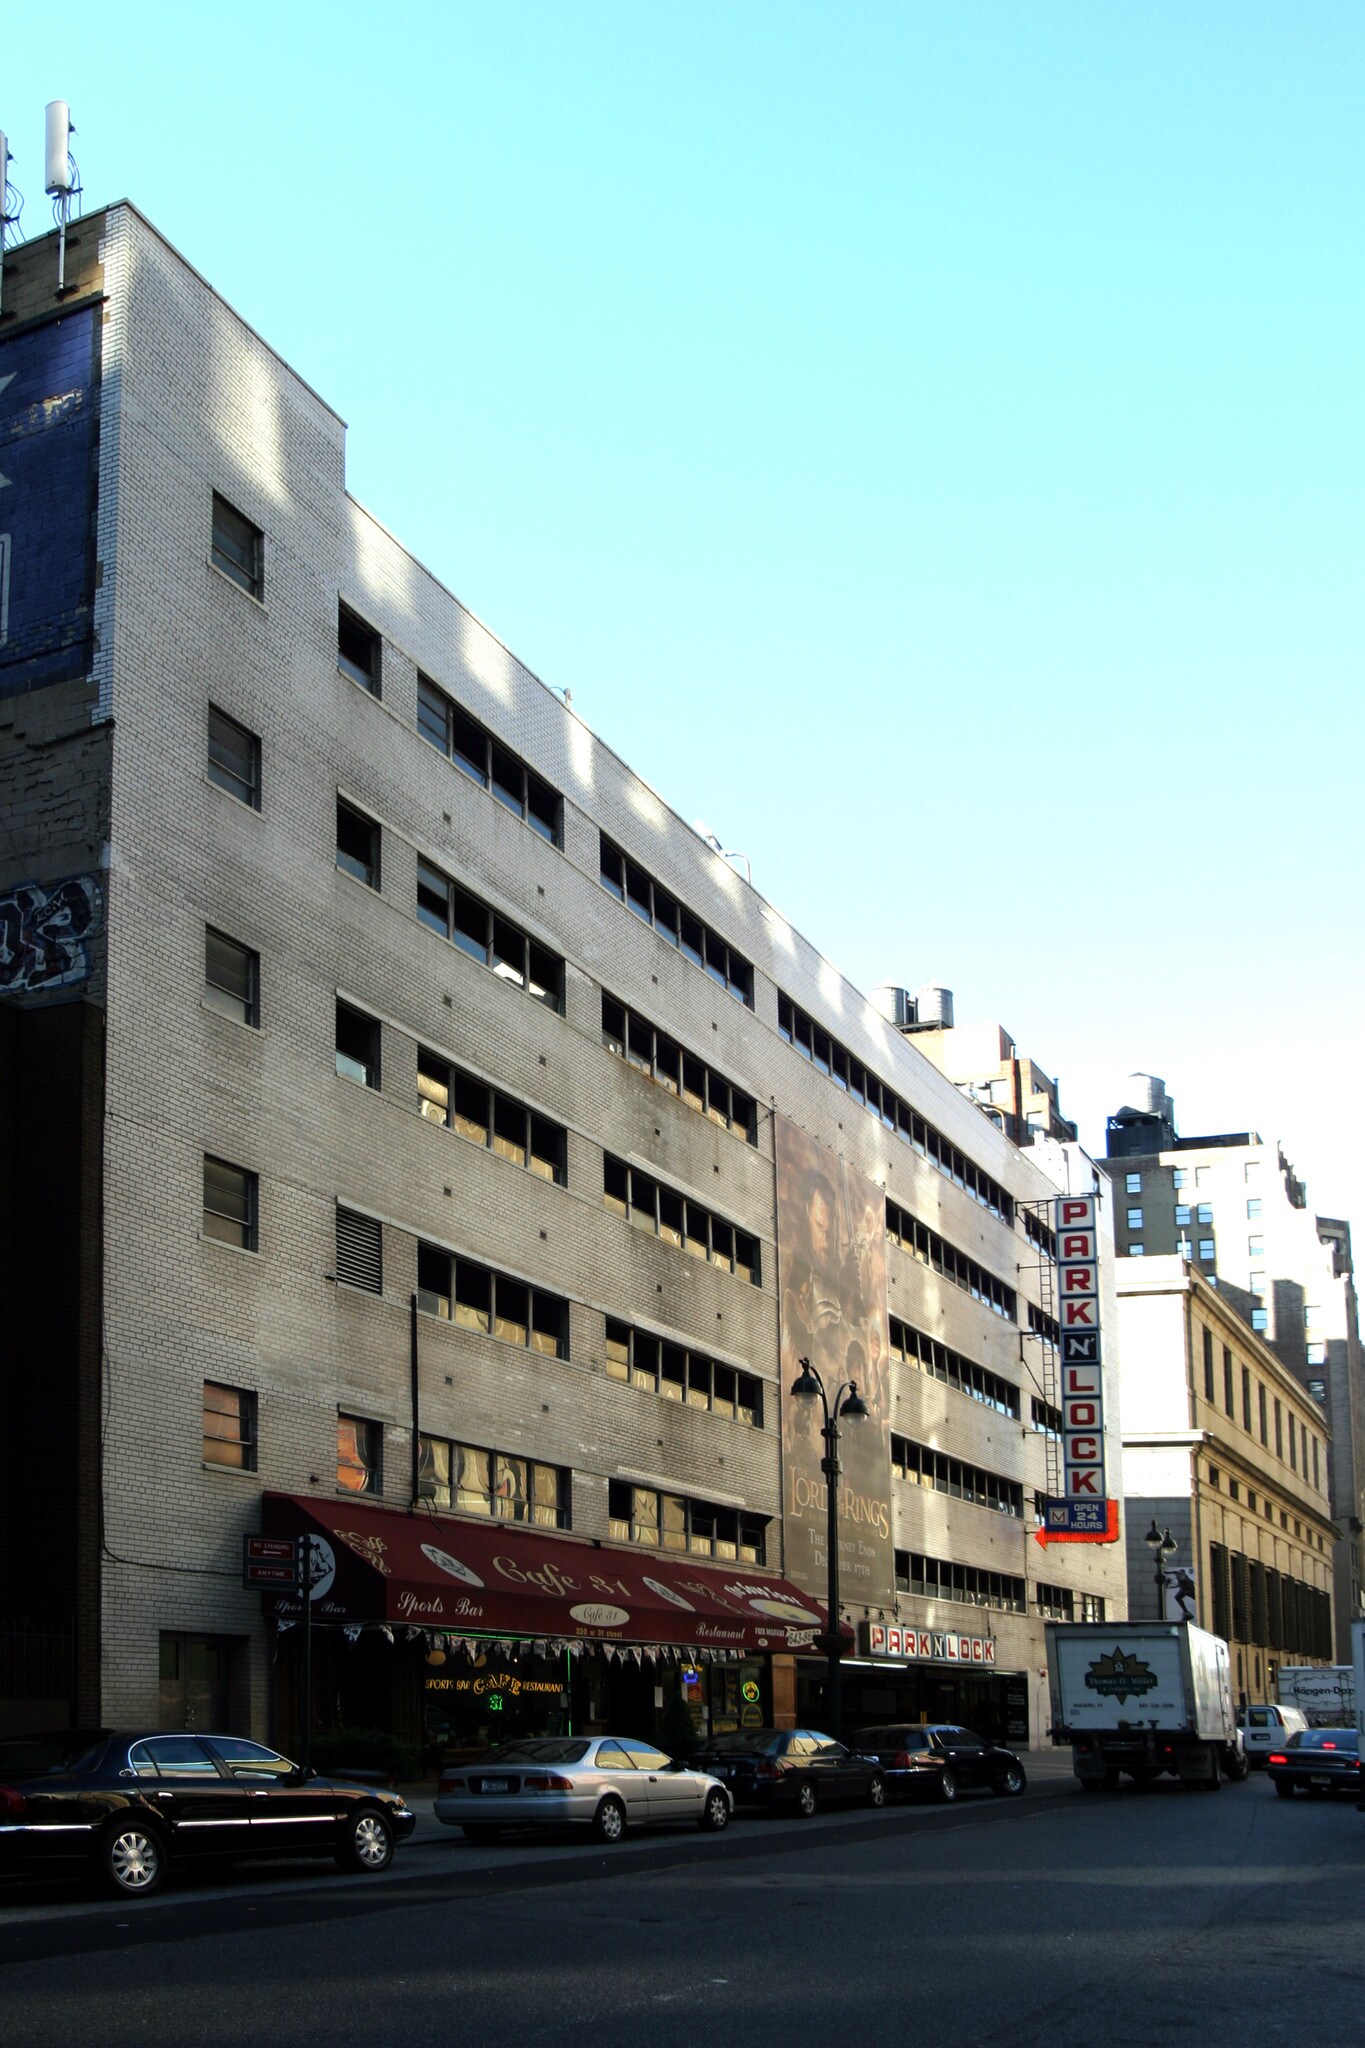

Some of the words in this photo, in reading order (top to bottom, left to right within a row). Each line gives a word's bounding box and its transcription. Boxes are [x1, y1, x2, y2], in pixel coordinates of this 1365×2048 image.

[1062, 1202, 1093, 1325] PARK
[1069, 1369, 1098, 1494] LOCK
[844, 1487, 889, 1540] RINGS
[1074, 1503, 1099, 1511] OPEN
[1076, 1512, 1098, 1521] 24
[1070, 1521, 1103, 1529] HOURS
[814, 1550, 852, 1573] DECBER
[492, 1556, 582, 1597] Cafe
[588, 1575, 632, 1597] 31
[320, 1601, 347, 1614] Bar
[397, 1591, 445, 1617] Sports
[455, 1597, 485, 1617] Bar
[695, 1621, 746, 1639] Restaurant
[872, 1627, 930, 1656] PARK
[948, 1637, 993, 1660] LOCK
[425, 1679, 454, 1690] SPORTS
[456, 1680, 471, 1690] BAR
[523, 1681, 564, 1693] RESTAURANT
